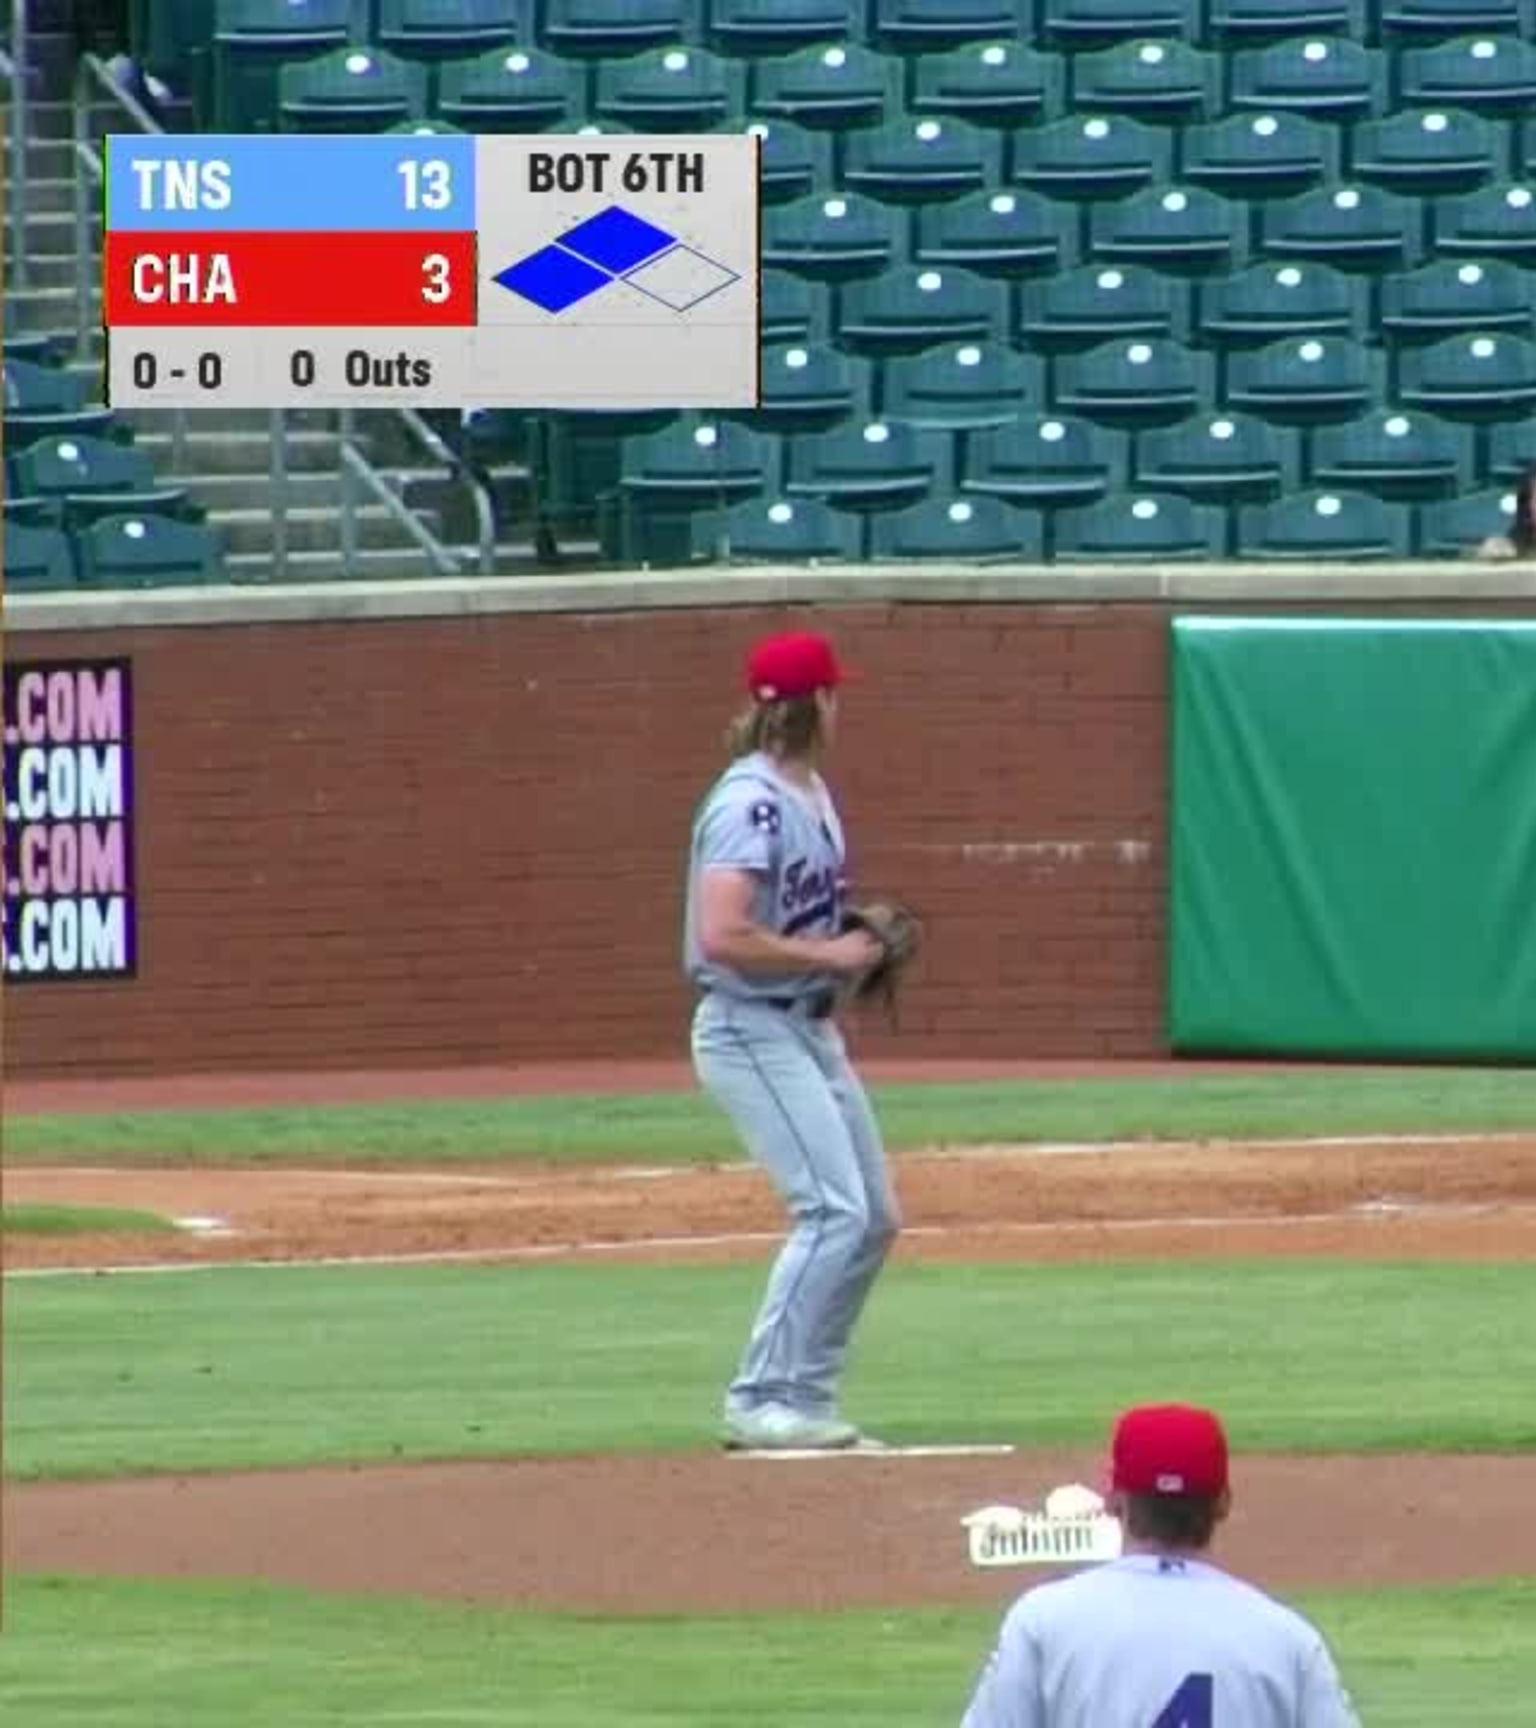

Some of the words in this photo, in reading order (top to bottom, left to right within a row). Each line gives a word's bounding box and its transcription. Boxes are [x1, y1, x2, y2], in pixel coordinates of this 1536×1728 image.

[0, 744, 122, 820] .COM
[0, 821, 124, 895] .COM
[0, 897, 126, 972] .COM
